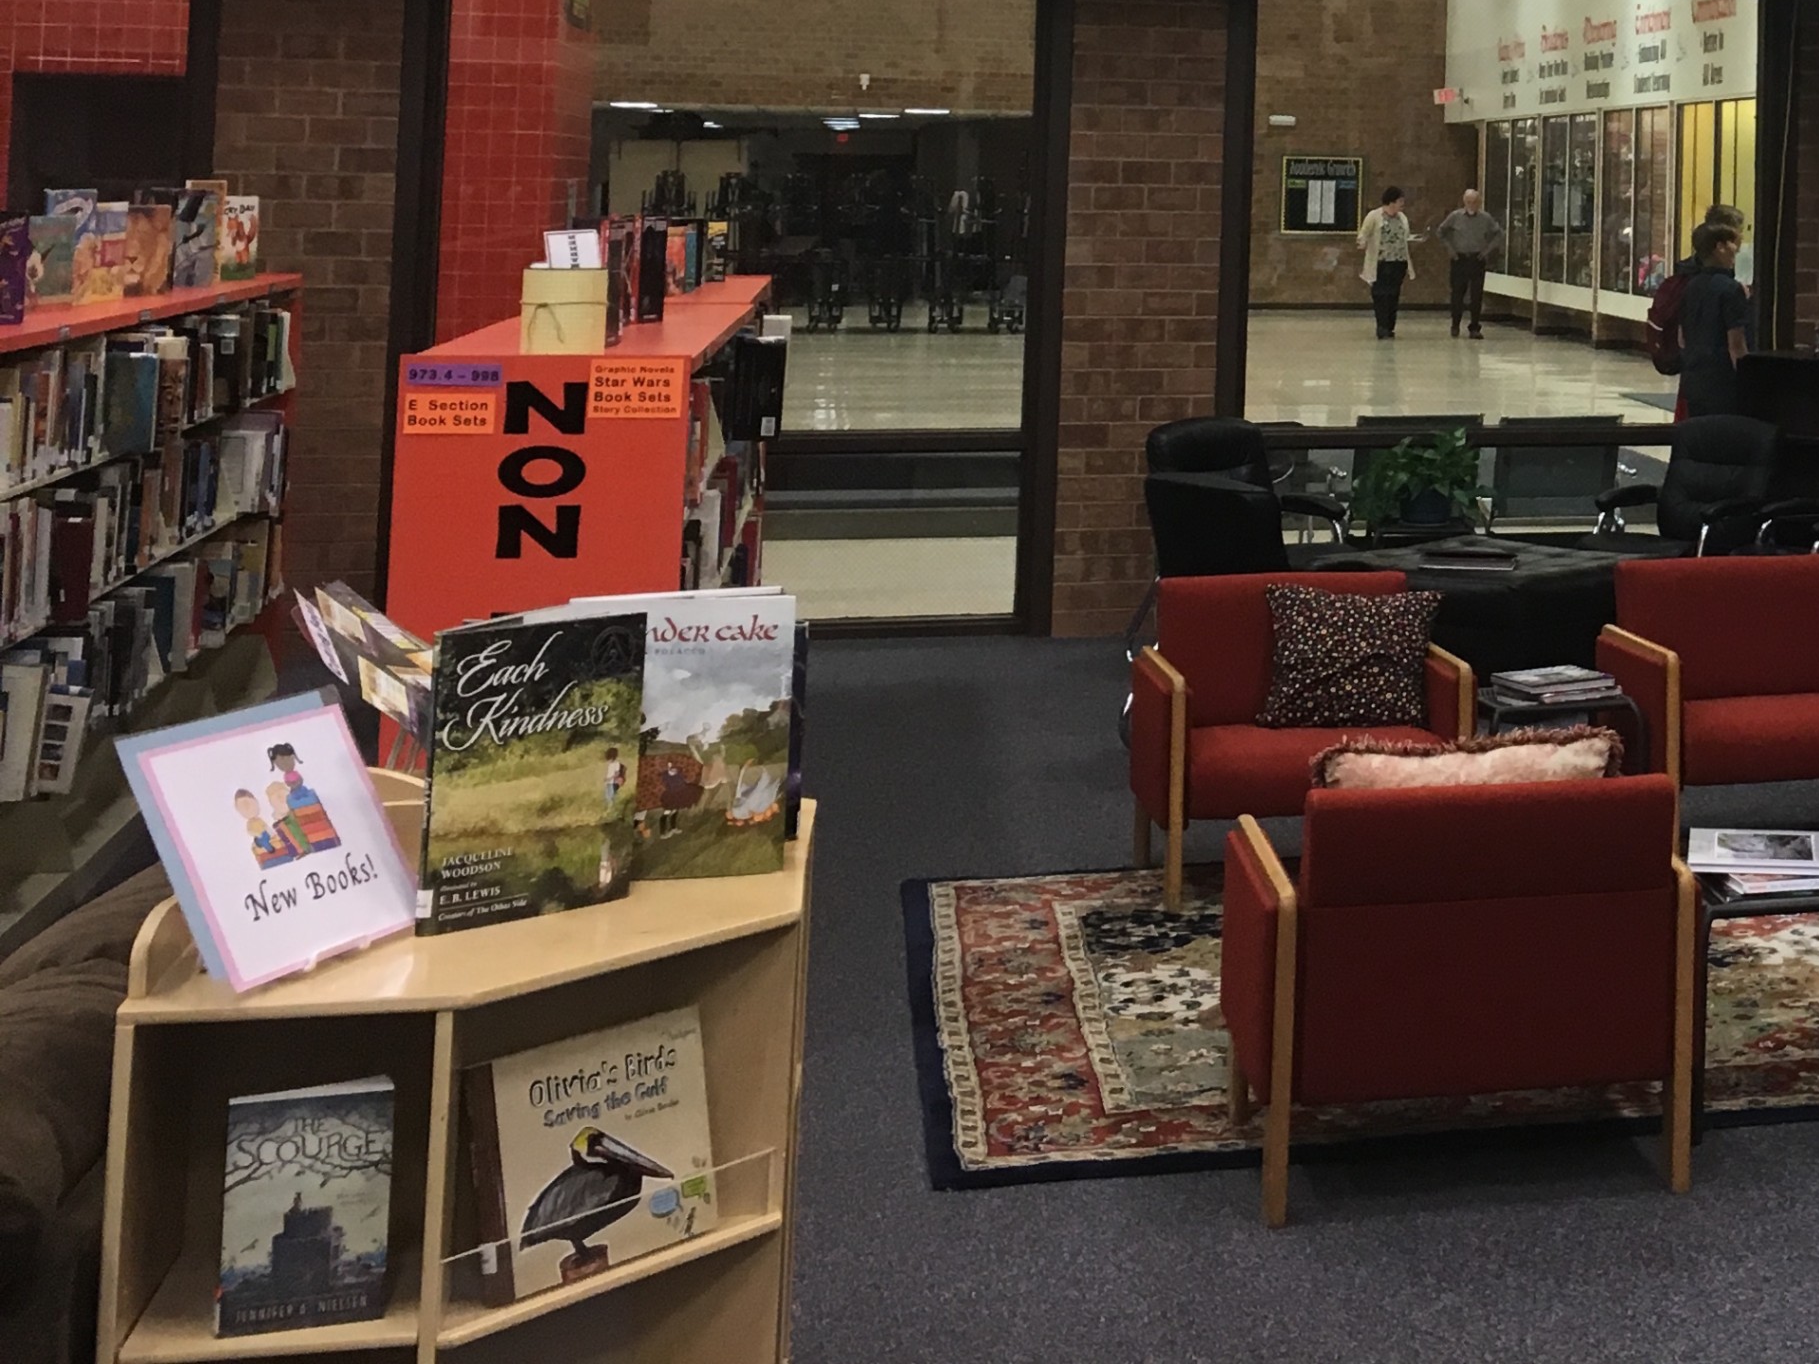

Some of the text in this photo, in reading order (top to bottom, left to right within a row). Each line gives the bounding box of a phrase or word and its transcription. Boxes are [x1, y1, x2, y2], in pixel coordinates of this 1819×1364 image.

[640, 366, 675, 374] Novels
[595, 376, 671, 388] Star Wars
[408, 399, 488, 411] E Section
[594, 391, 671, 403] Book Sets
[408, 415, 487, 427] Book Sets
[715, 614, 779, 641] cake
[457, 631, 564, 697] Each
[442, 680, 609, 751] Kindness
[441, 861, 501, 879] WOODSON
[244, 852, 378, 921] New Books!
[465, 886, 501, 901] LEWIS
[529, 1044, 676, 1107] Olivia's Birds
[543, 1101, 600, 1127] Saving
[604, 1091, 631, 1111] the
[294, 1115, 328, 1135] THE
[236, 1131, 383, 1165] SCOURGE
